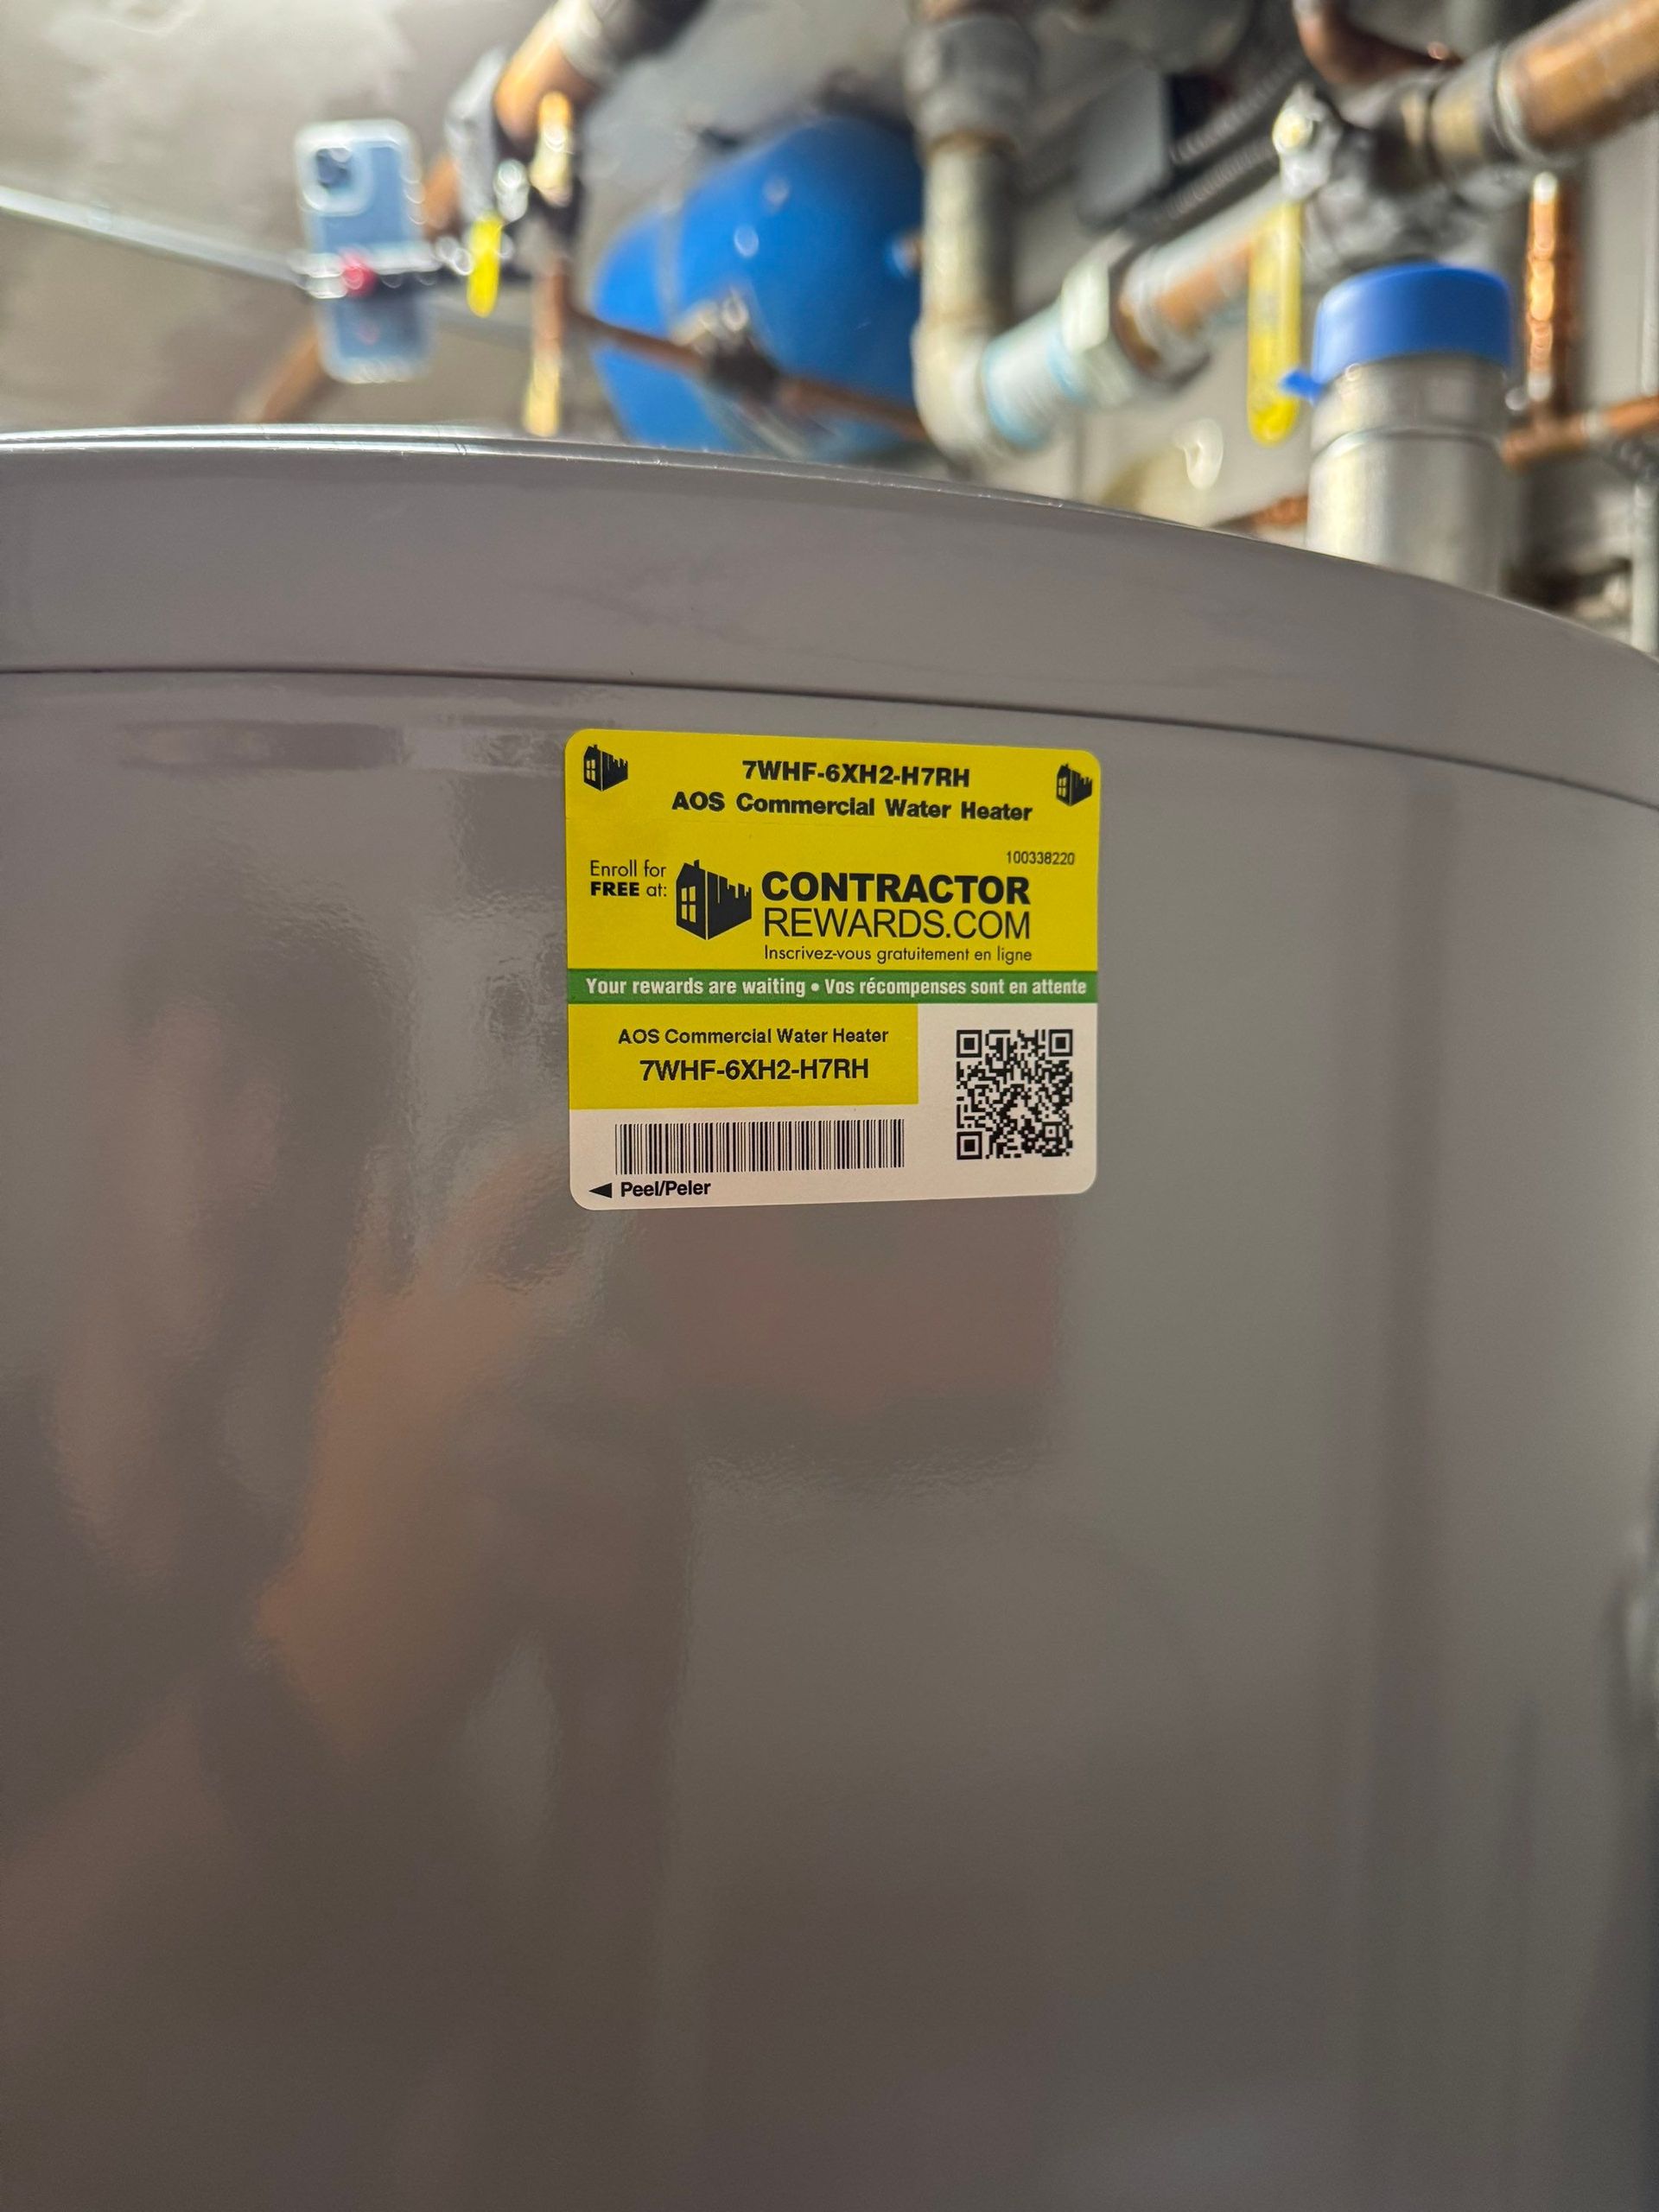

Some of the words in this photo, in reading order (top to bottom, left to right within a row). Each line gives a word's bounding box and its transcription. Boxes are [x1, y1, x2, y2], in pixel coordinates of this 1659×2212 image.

[742, 760, 969, 788] 7WHF-6XH2-H7RH
[672, 791, 725, 811] AOS
[737, 792, 875, 817] Commercial
[885, 798, 951, 819] Water
[961, 801, 1033, 821] Heater
[1007, 850, 1075, 865] 100338220
[590, 861, 637, 878] Enroll
[644, 861, 666, 878] for
[591, 880, 639, 896] FREE
[646, 881, 667, 897] at:
[761, 871, 1030, 905] CONTRACTOR
[765, 906, 1031, 939] REWARDS.COM
[765, 944, 871, 961] Inscrivez-vous
[877, 946, 969, 963] gratuitement
[974, 950, 992, 962] en
[997, 948, 1032, 964] ligne
[587, 978, 626, 995] Your
[632, 977, 702, 995] rewards
[709, 980, 736, 995] are
[742, 977, 806, 997] waiting
[824, 979, 855, 995] Vos
[860, 976, 966, 996] récompenses
[970, 980, 1005, 995] sont
[1010, 982, 1028, 995] en
[1033, 980, 1086, 995] attente
[618, 1028, 659, 1045] AOS
[665, 1027, 772, 1044] Commercial
[778, 1027, 829, 1043] Water
[833, 1027, 889, 1043] Heater
[639, 1058, 869, 1082] 7WHF-6XH2-H7RH
[620, 1179, 711, 1198] Peel/Peler
